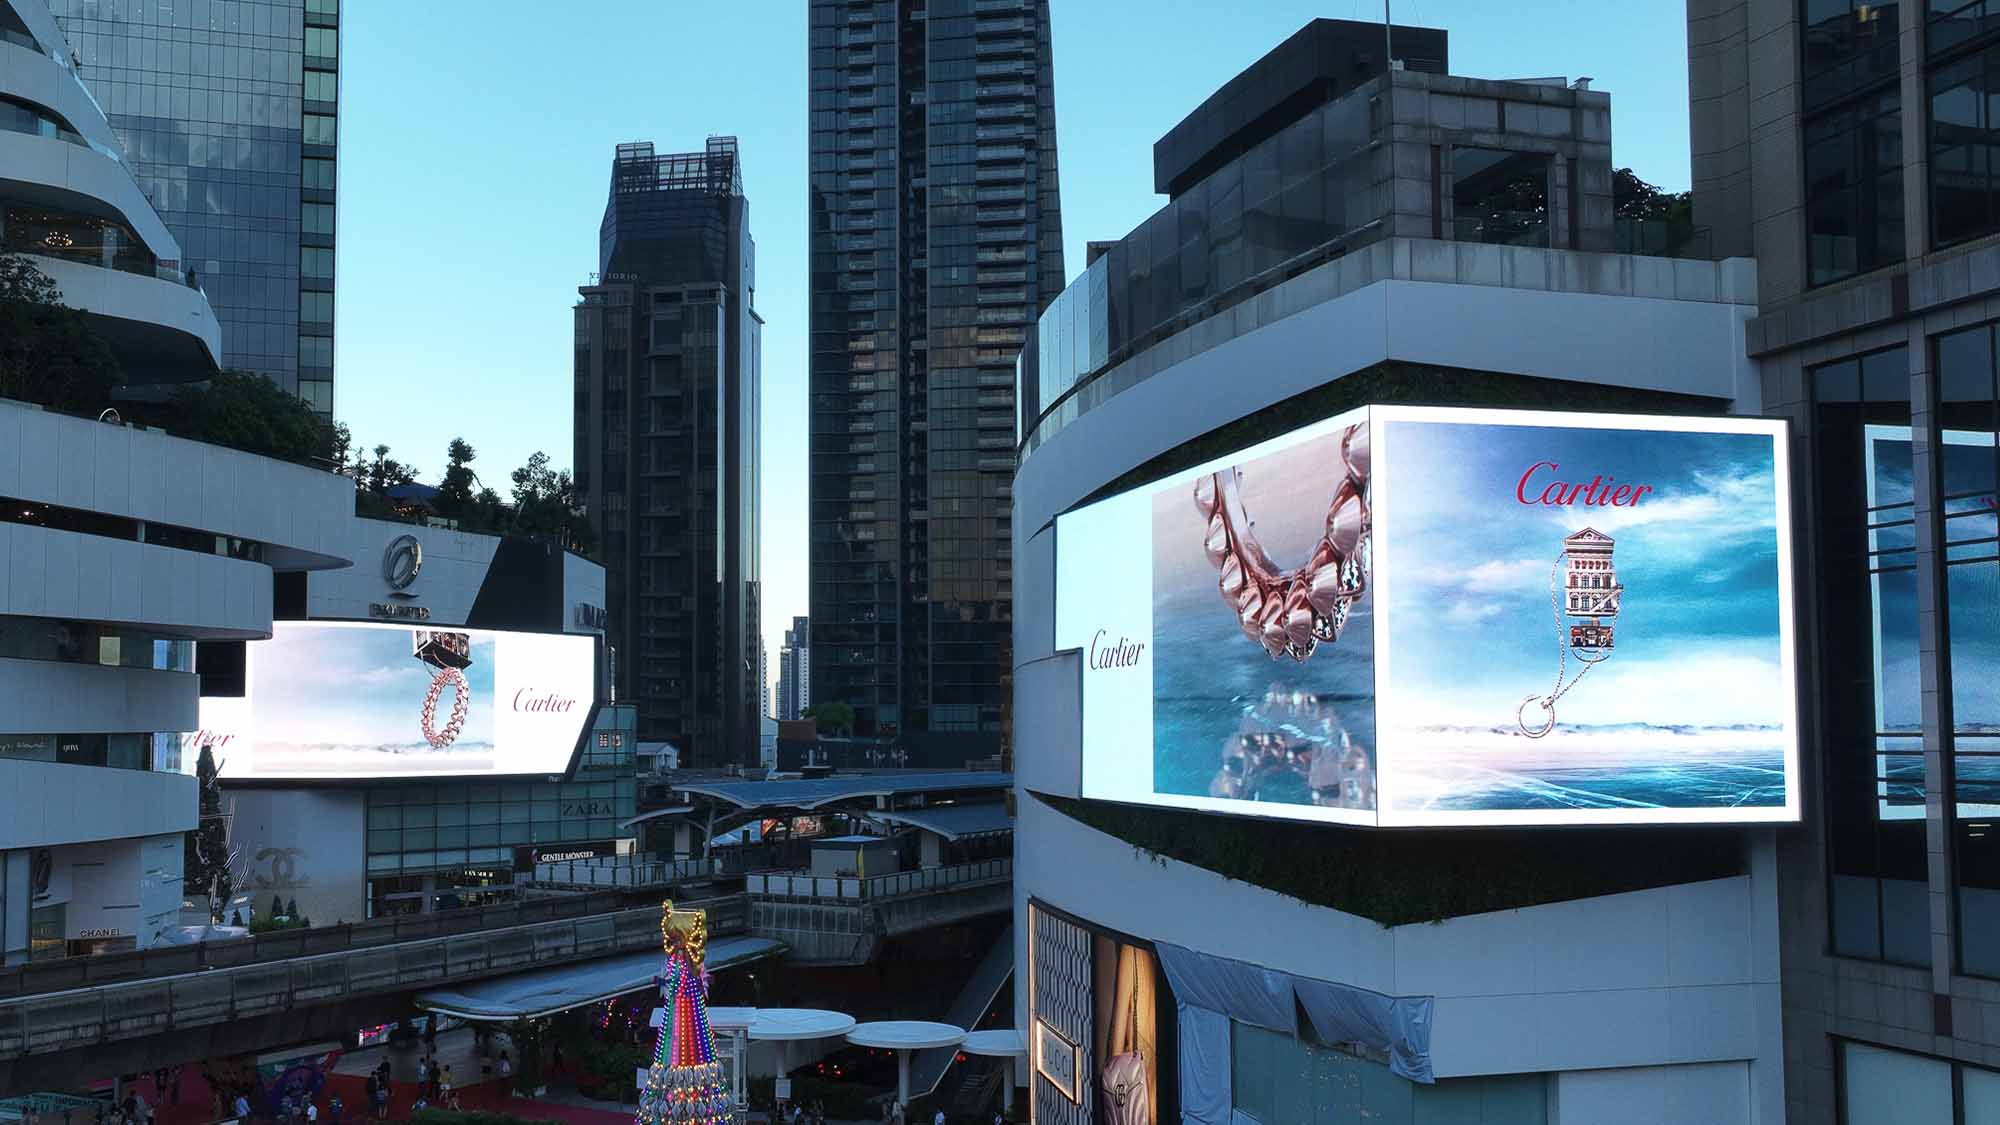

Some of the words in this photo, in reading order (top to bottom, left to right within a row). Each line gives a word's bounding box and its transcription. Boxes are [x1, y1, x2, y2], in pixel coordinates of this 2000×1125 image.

[1515, 460, 1655, 508] Cartier
[1090, 628, 1145, 671] Cartier
[512, 687, 576, 713] Cartier
[182, 729, 236, 748] rtier
[563, 801, 612, 816] ZARA
[541, 853, 564, 862] GENTLE
[565, 851, 594, 860] MONSTER
[80, 928, 120, 938] CHANEL
